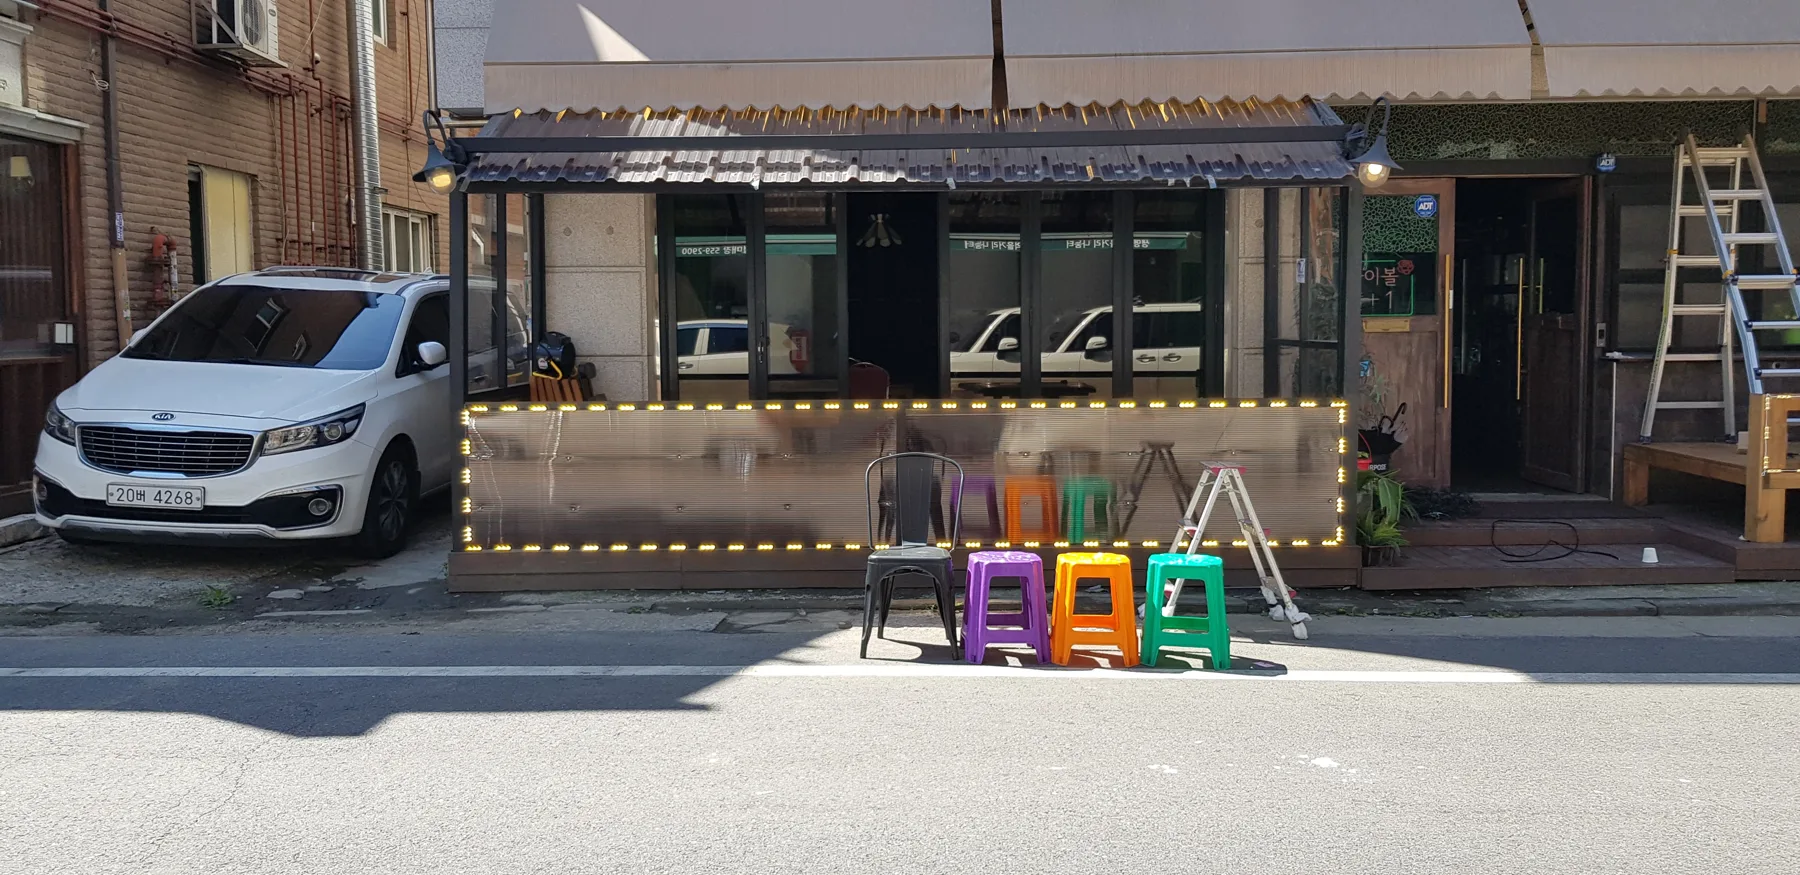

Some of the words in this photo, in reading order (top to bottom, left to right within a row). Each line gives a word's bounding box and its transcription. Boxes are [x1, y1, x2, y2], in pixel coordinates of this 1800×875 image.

[1418, 202, 1434, 211] ADT
[1361, 266, 1400, 287] 이볼
[116, 487, 146, 503] 20버
[153, 489, 194, 506] 4268
